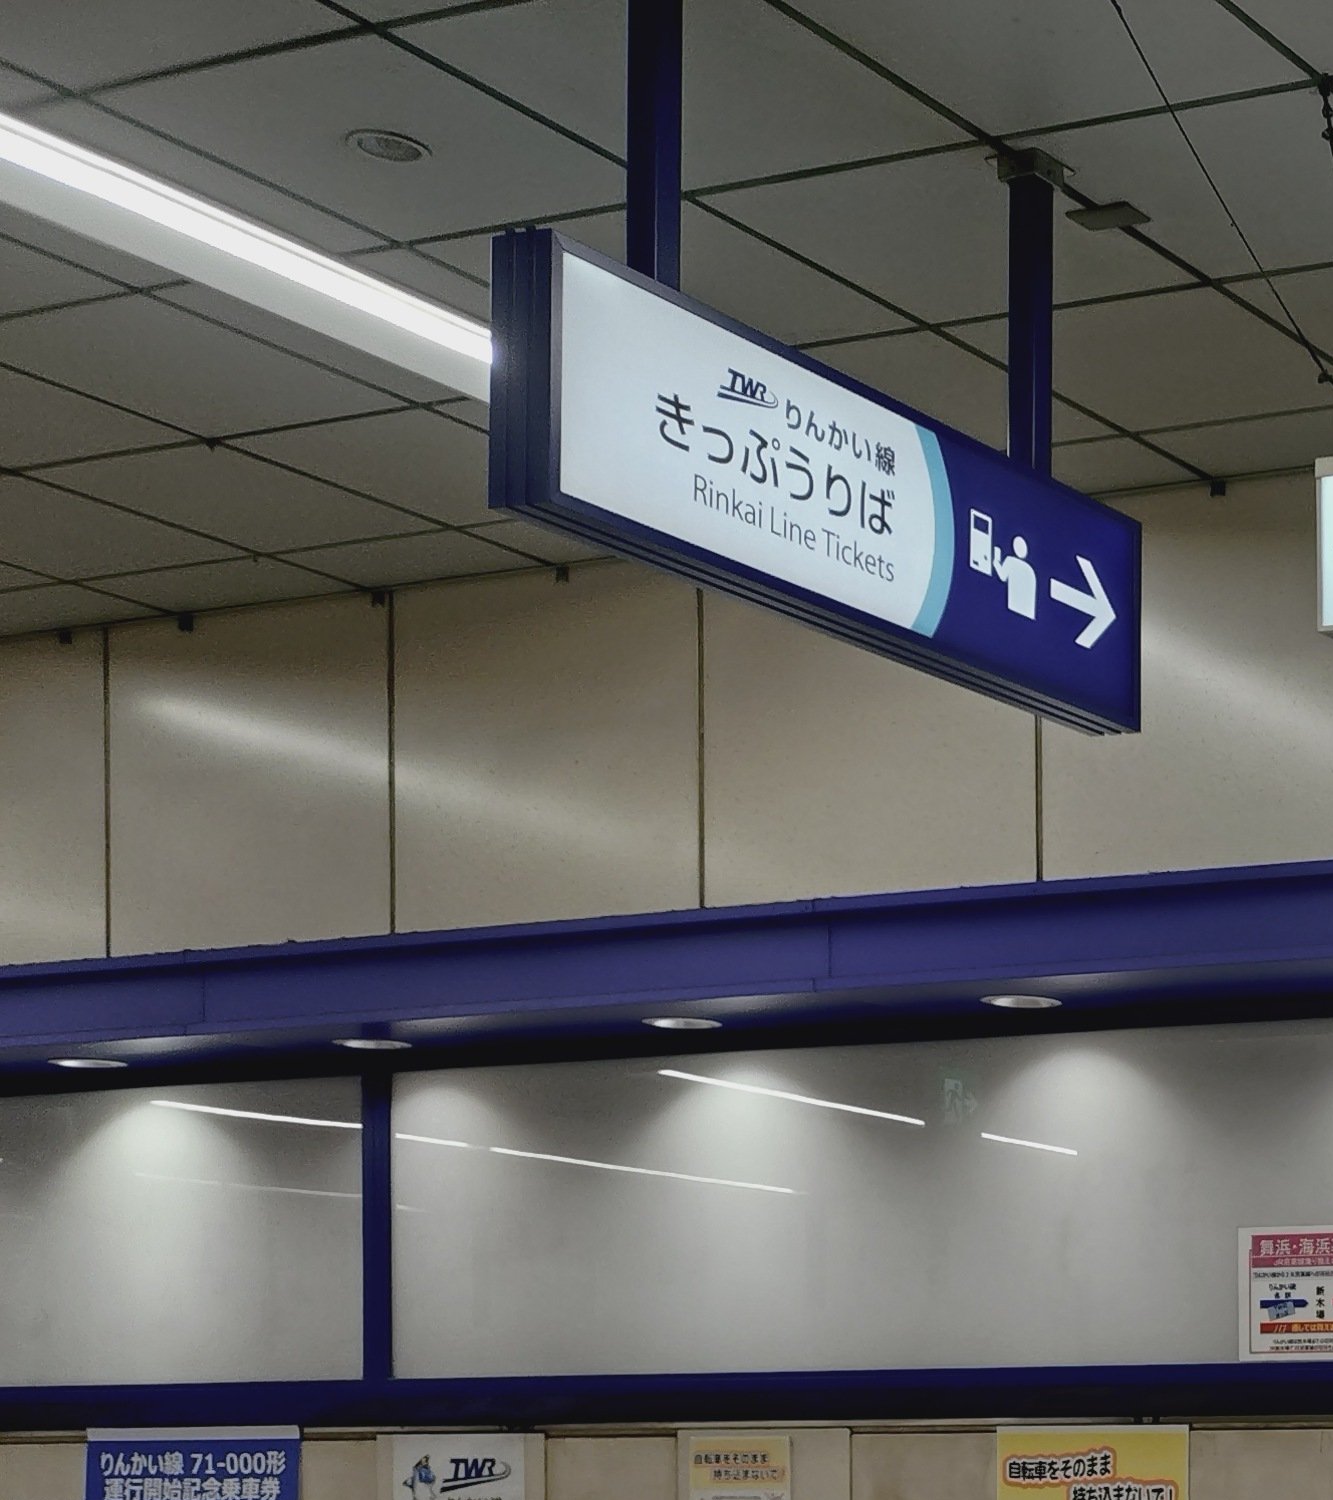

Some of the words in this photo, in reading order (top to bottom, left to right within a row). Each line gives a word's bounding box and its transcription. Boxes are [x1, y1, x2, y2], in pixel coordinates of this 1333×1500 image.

[722, 367, 772, 405] TWR
[785, 398, 896, 475] りんかい線
[656, 392, 893, 535] きっぷうりば
[693, 473, 763, 527] Rinkai
[770, 509, 817, 550] Line
[821, 527, 894, 582] Tickets
[100, 1452, 184, 1476] りんかい線
[190, 1450, 286, 1475] 71-000形
[444, 1457, 504, 1487] TWR
[1009, 1455, 1112, 1479] 自転車をそのまま
